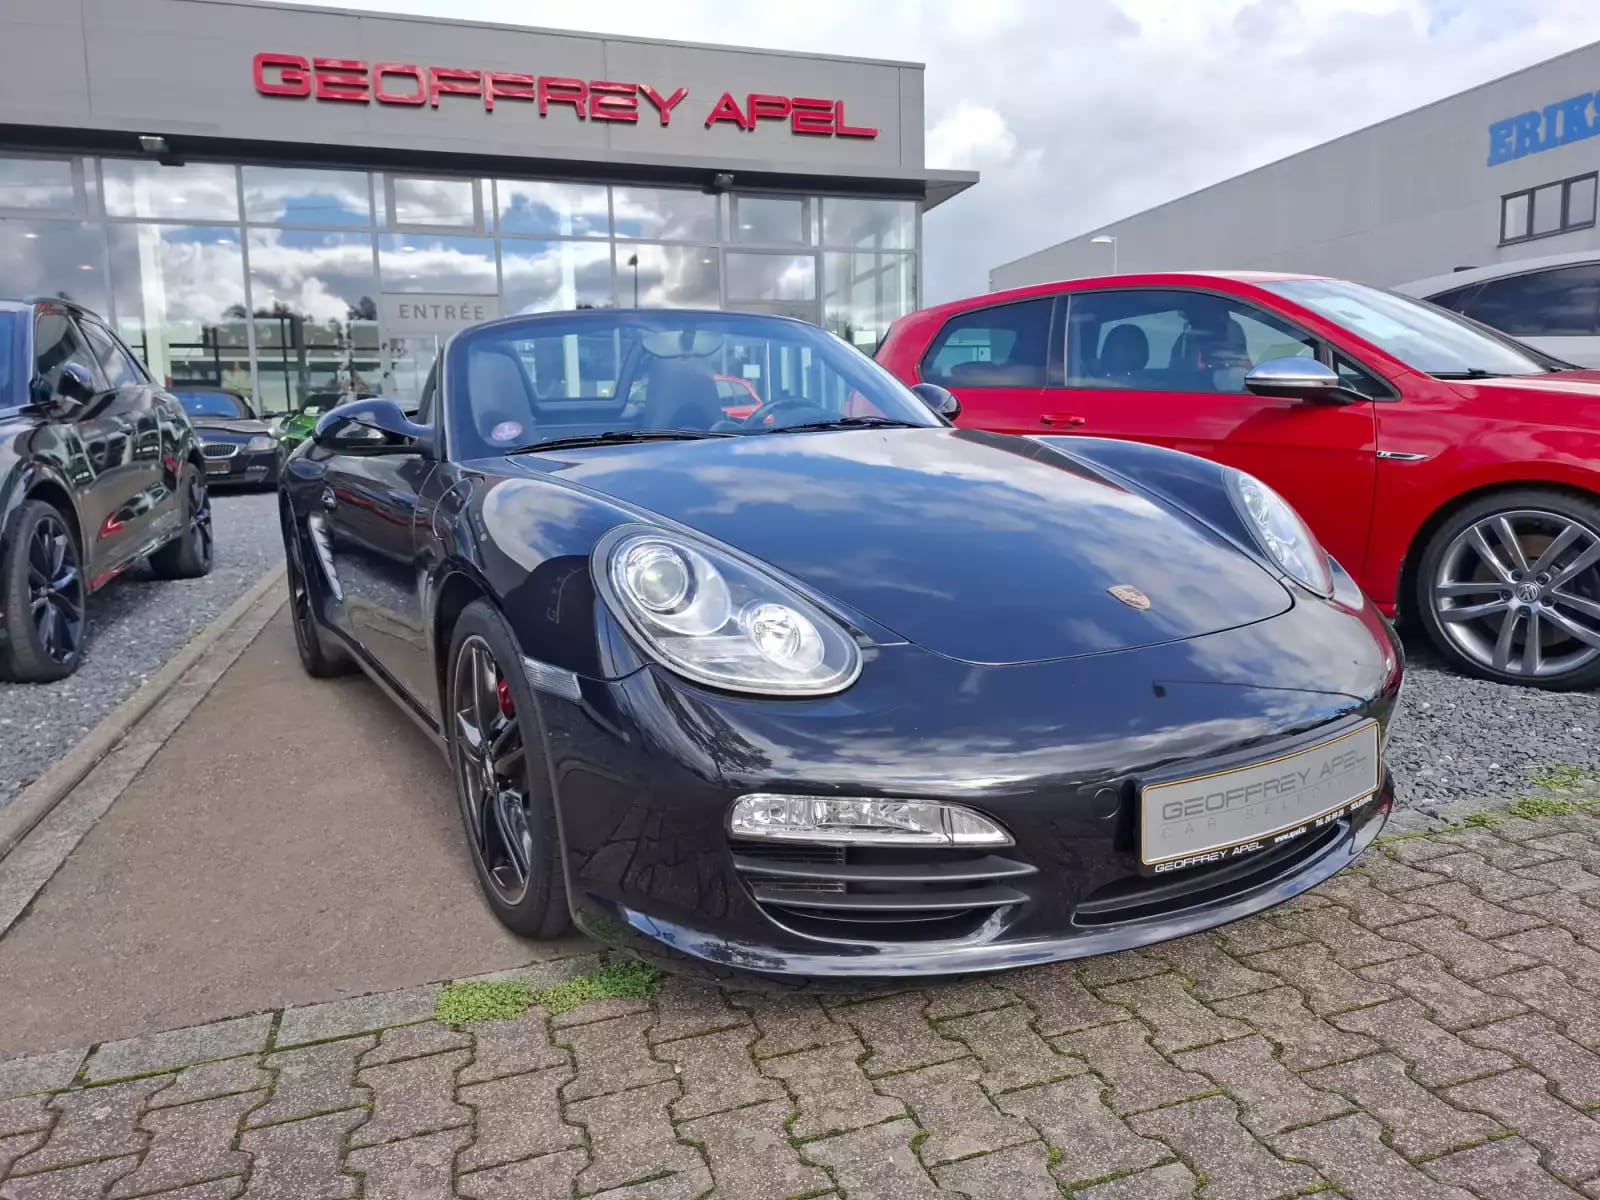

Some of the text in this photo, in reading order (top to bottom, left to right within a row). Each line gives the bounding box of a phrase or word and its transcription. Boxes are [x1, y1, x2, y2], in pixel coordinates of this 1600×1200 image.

[253, 52, 879, 137] GEOFFREY APEL
[399, 302, 485, 321] ENTRÉE
[1161, 749, 1368, 821] GEOFFREY APEL
[1161, 816, 1217, 840] CAR
[1154, 850, 1228, 873] GEOFFREY
[1231, 841, 1265, 856] APEL
